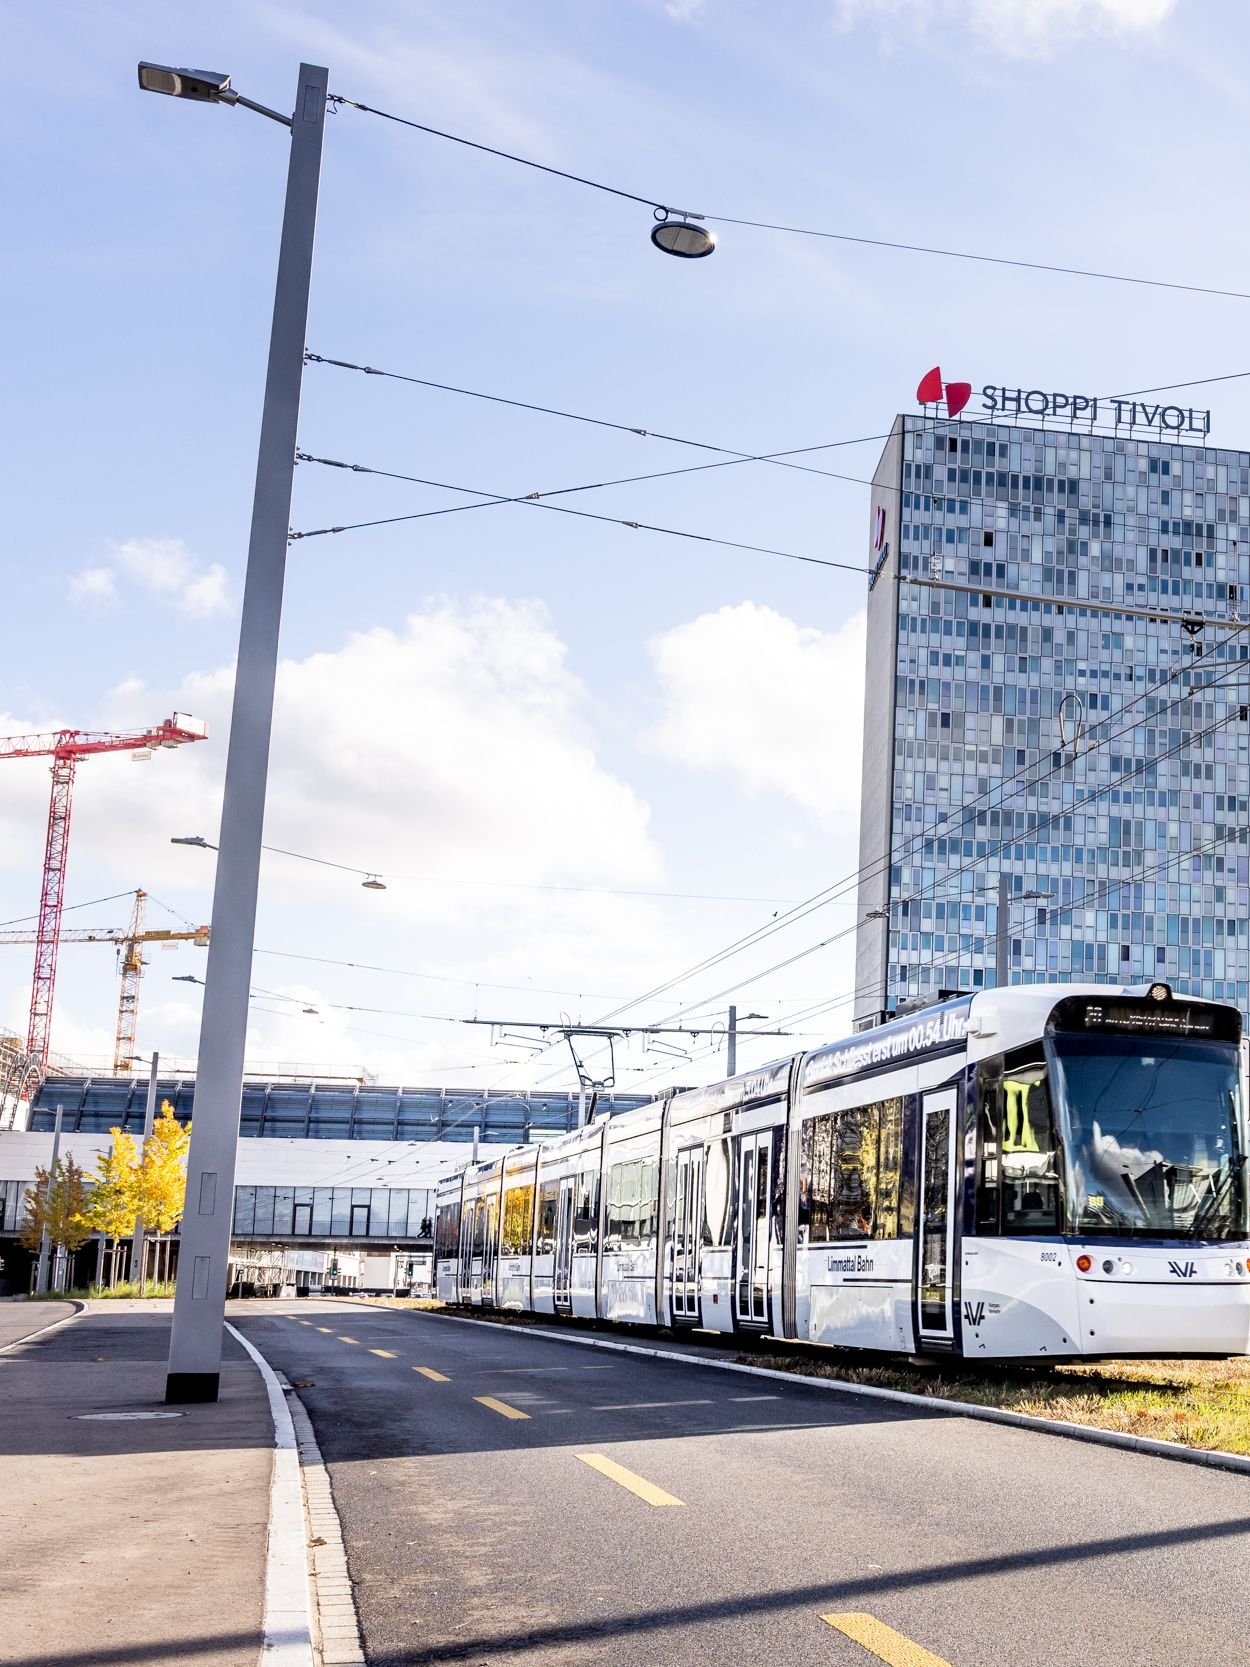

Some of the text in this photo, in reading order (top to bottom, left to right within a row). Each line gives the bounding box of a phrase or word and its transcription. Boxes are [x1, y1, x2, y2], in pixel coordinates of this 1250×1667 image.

[982, 385, 1210, 433] SHOPPI TIVOLI
[828, 1255, 874, 1272] Limmattal Bahn
[1040, 1252, 1057, 1262] 8002
